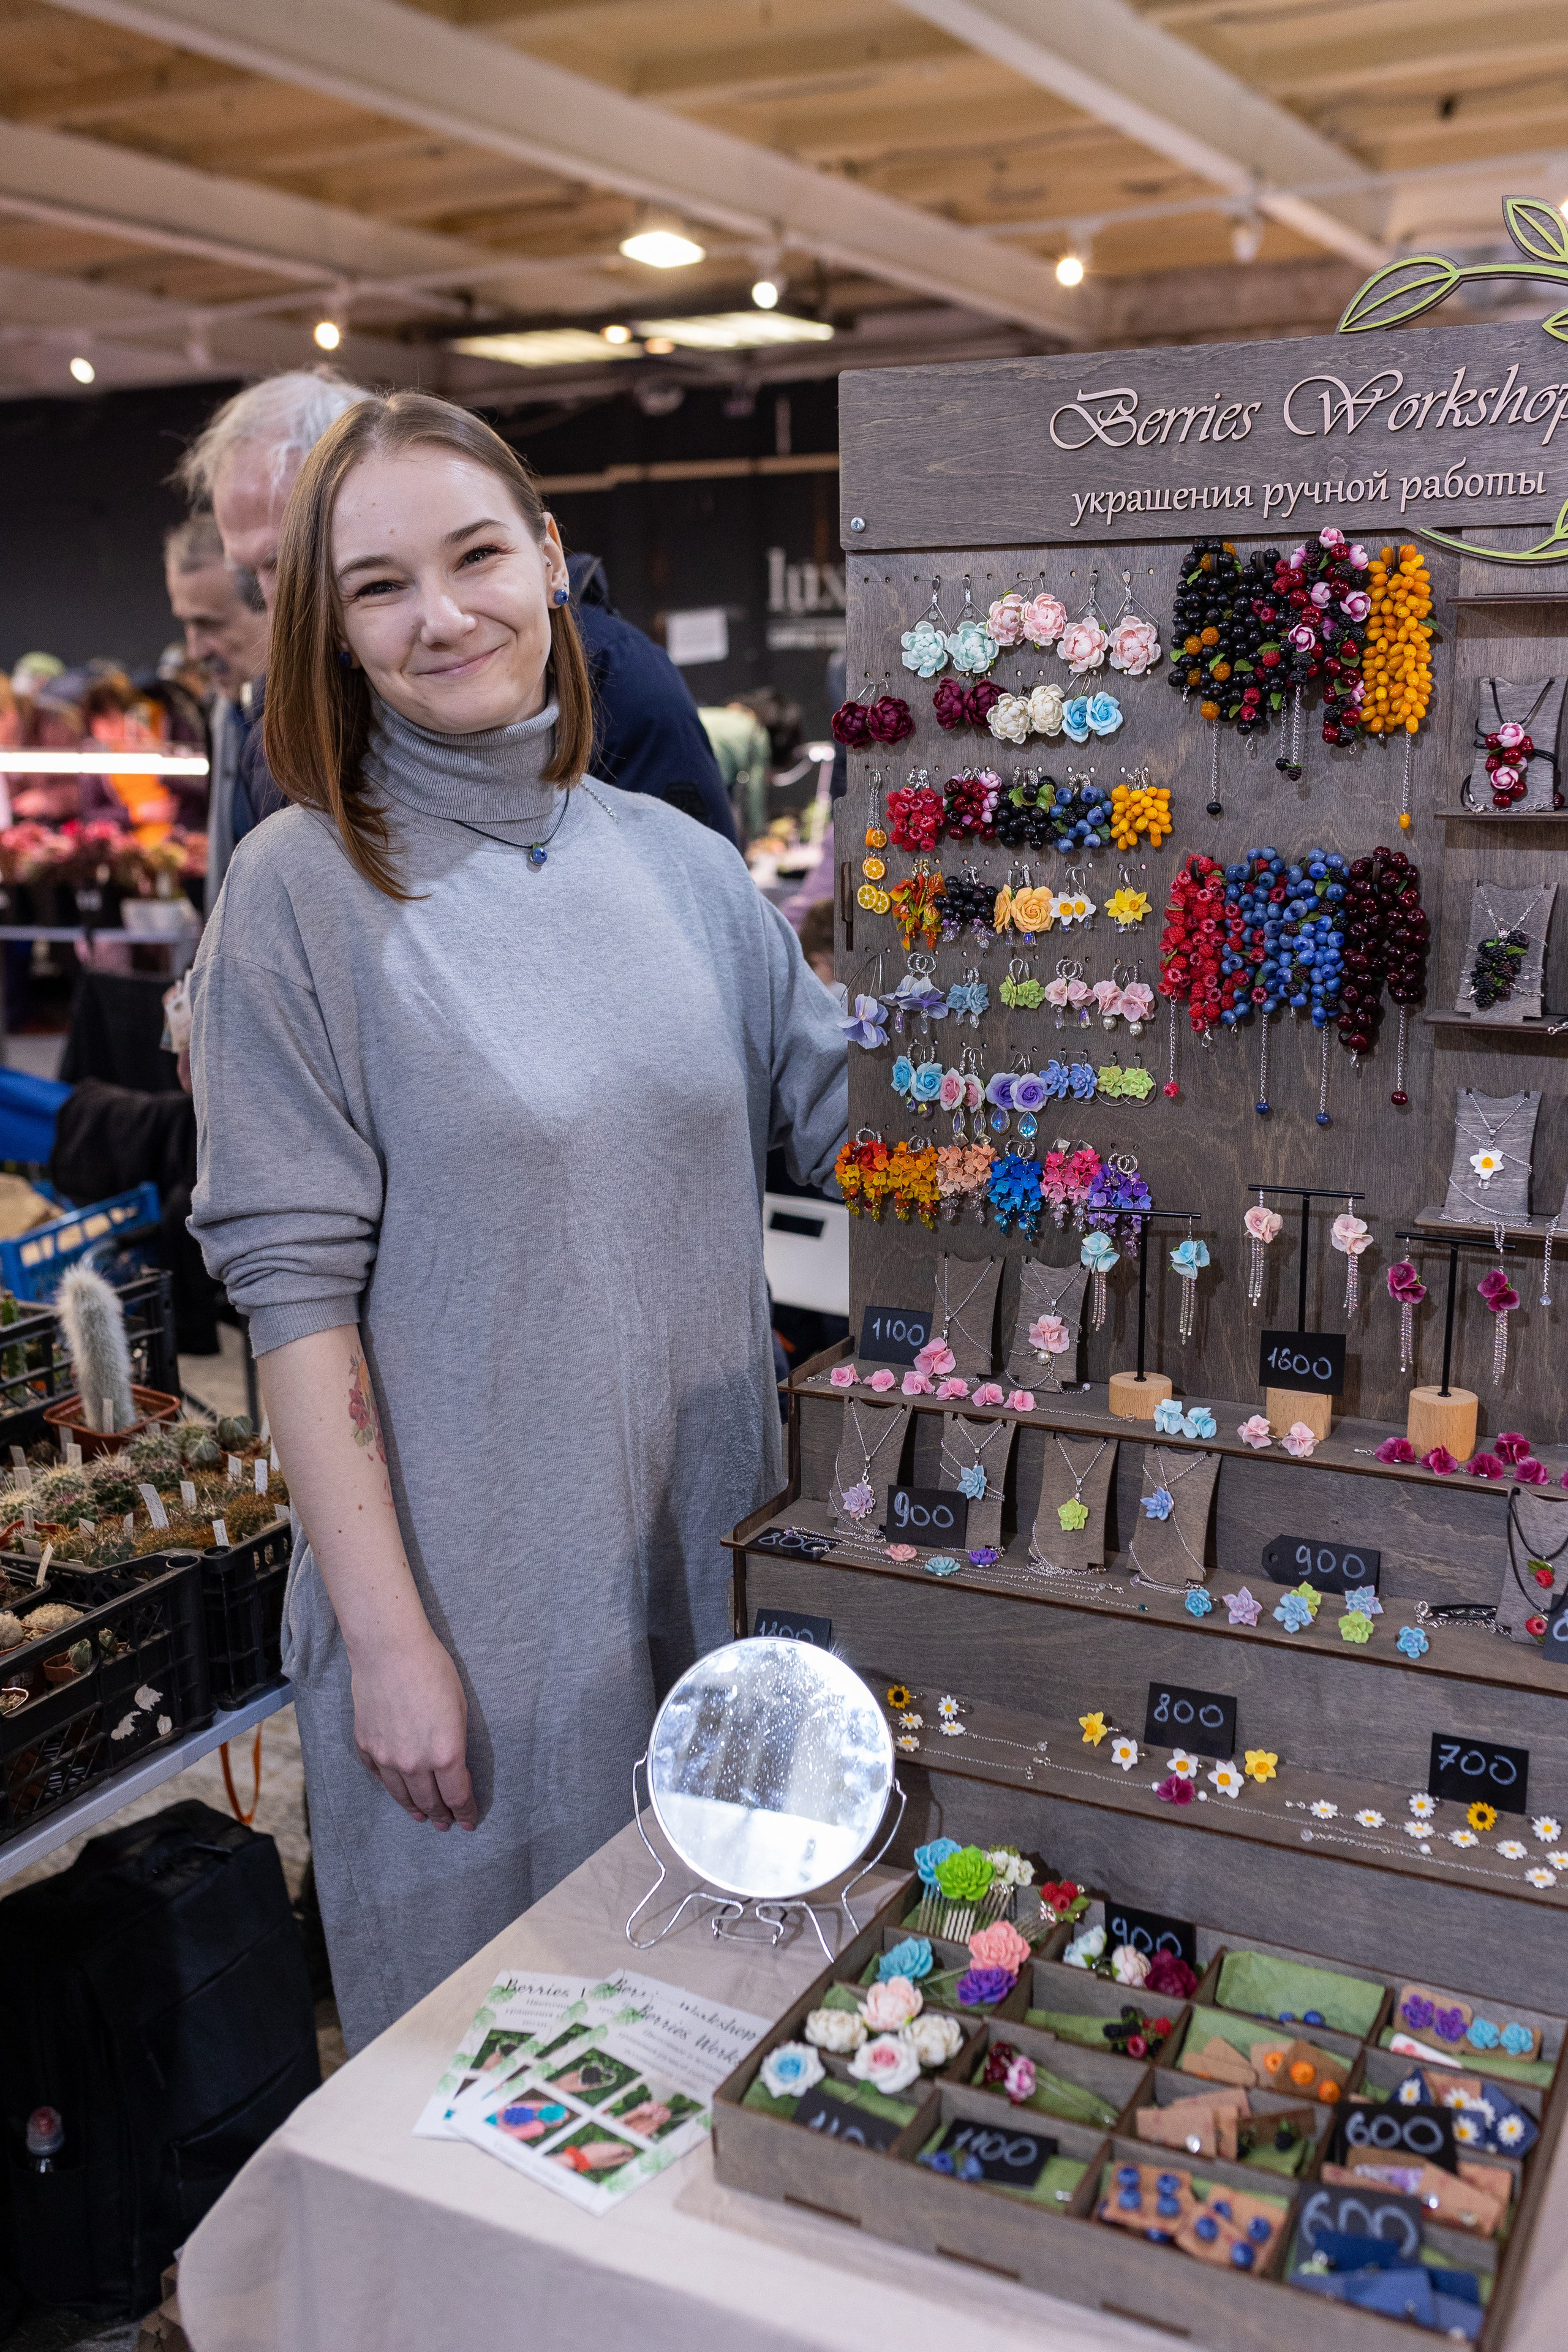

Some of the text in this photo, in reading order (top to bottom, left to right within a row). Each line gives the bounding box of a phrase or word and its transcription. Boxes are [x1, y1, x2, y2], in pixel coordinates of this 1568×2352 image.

[1048, 363, 1568, 451] Berries Workshop
[1069, 457, 1546, 527] украшения ручной работы
[871, 1318, 925, 1346] 1100
[894, 1491, 954, 1528] 900
[758, 1532, 829, 1553] 800
[1295, 1545, 1366, 1579] 900
[1153, 1694, 1224, 1728] 800
[1438, 1744, 1517, 1785] 700
[1112, 1917, 1182, 1958] 900
[1346, 2111, 1444, 2155] 600
